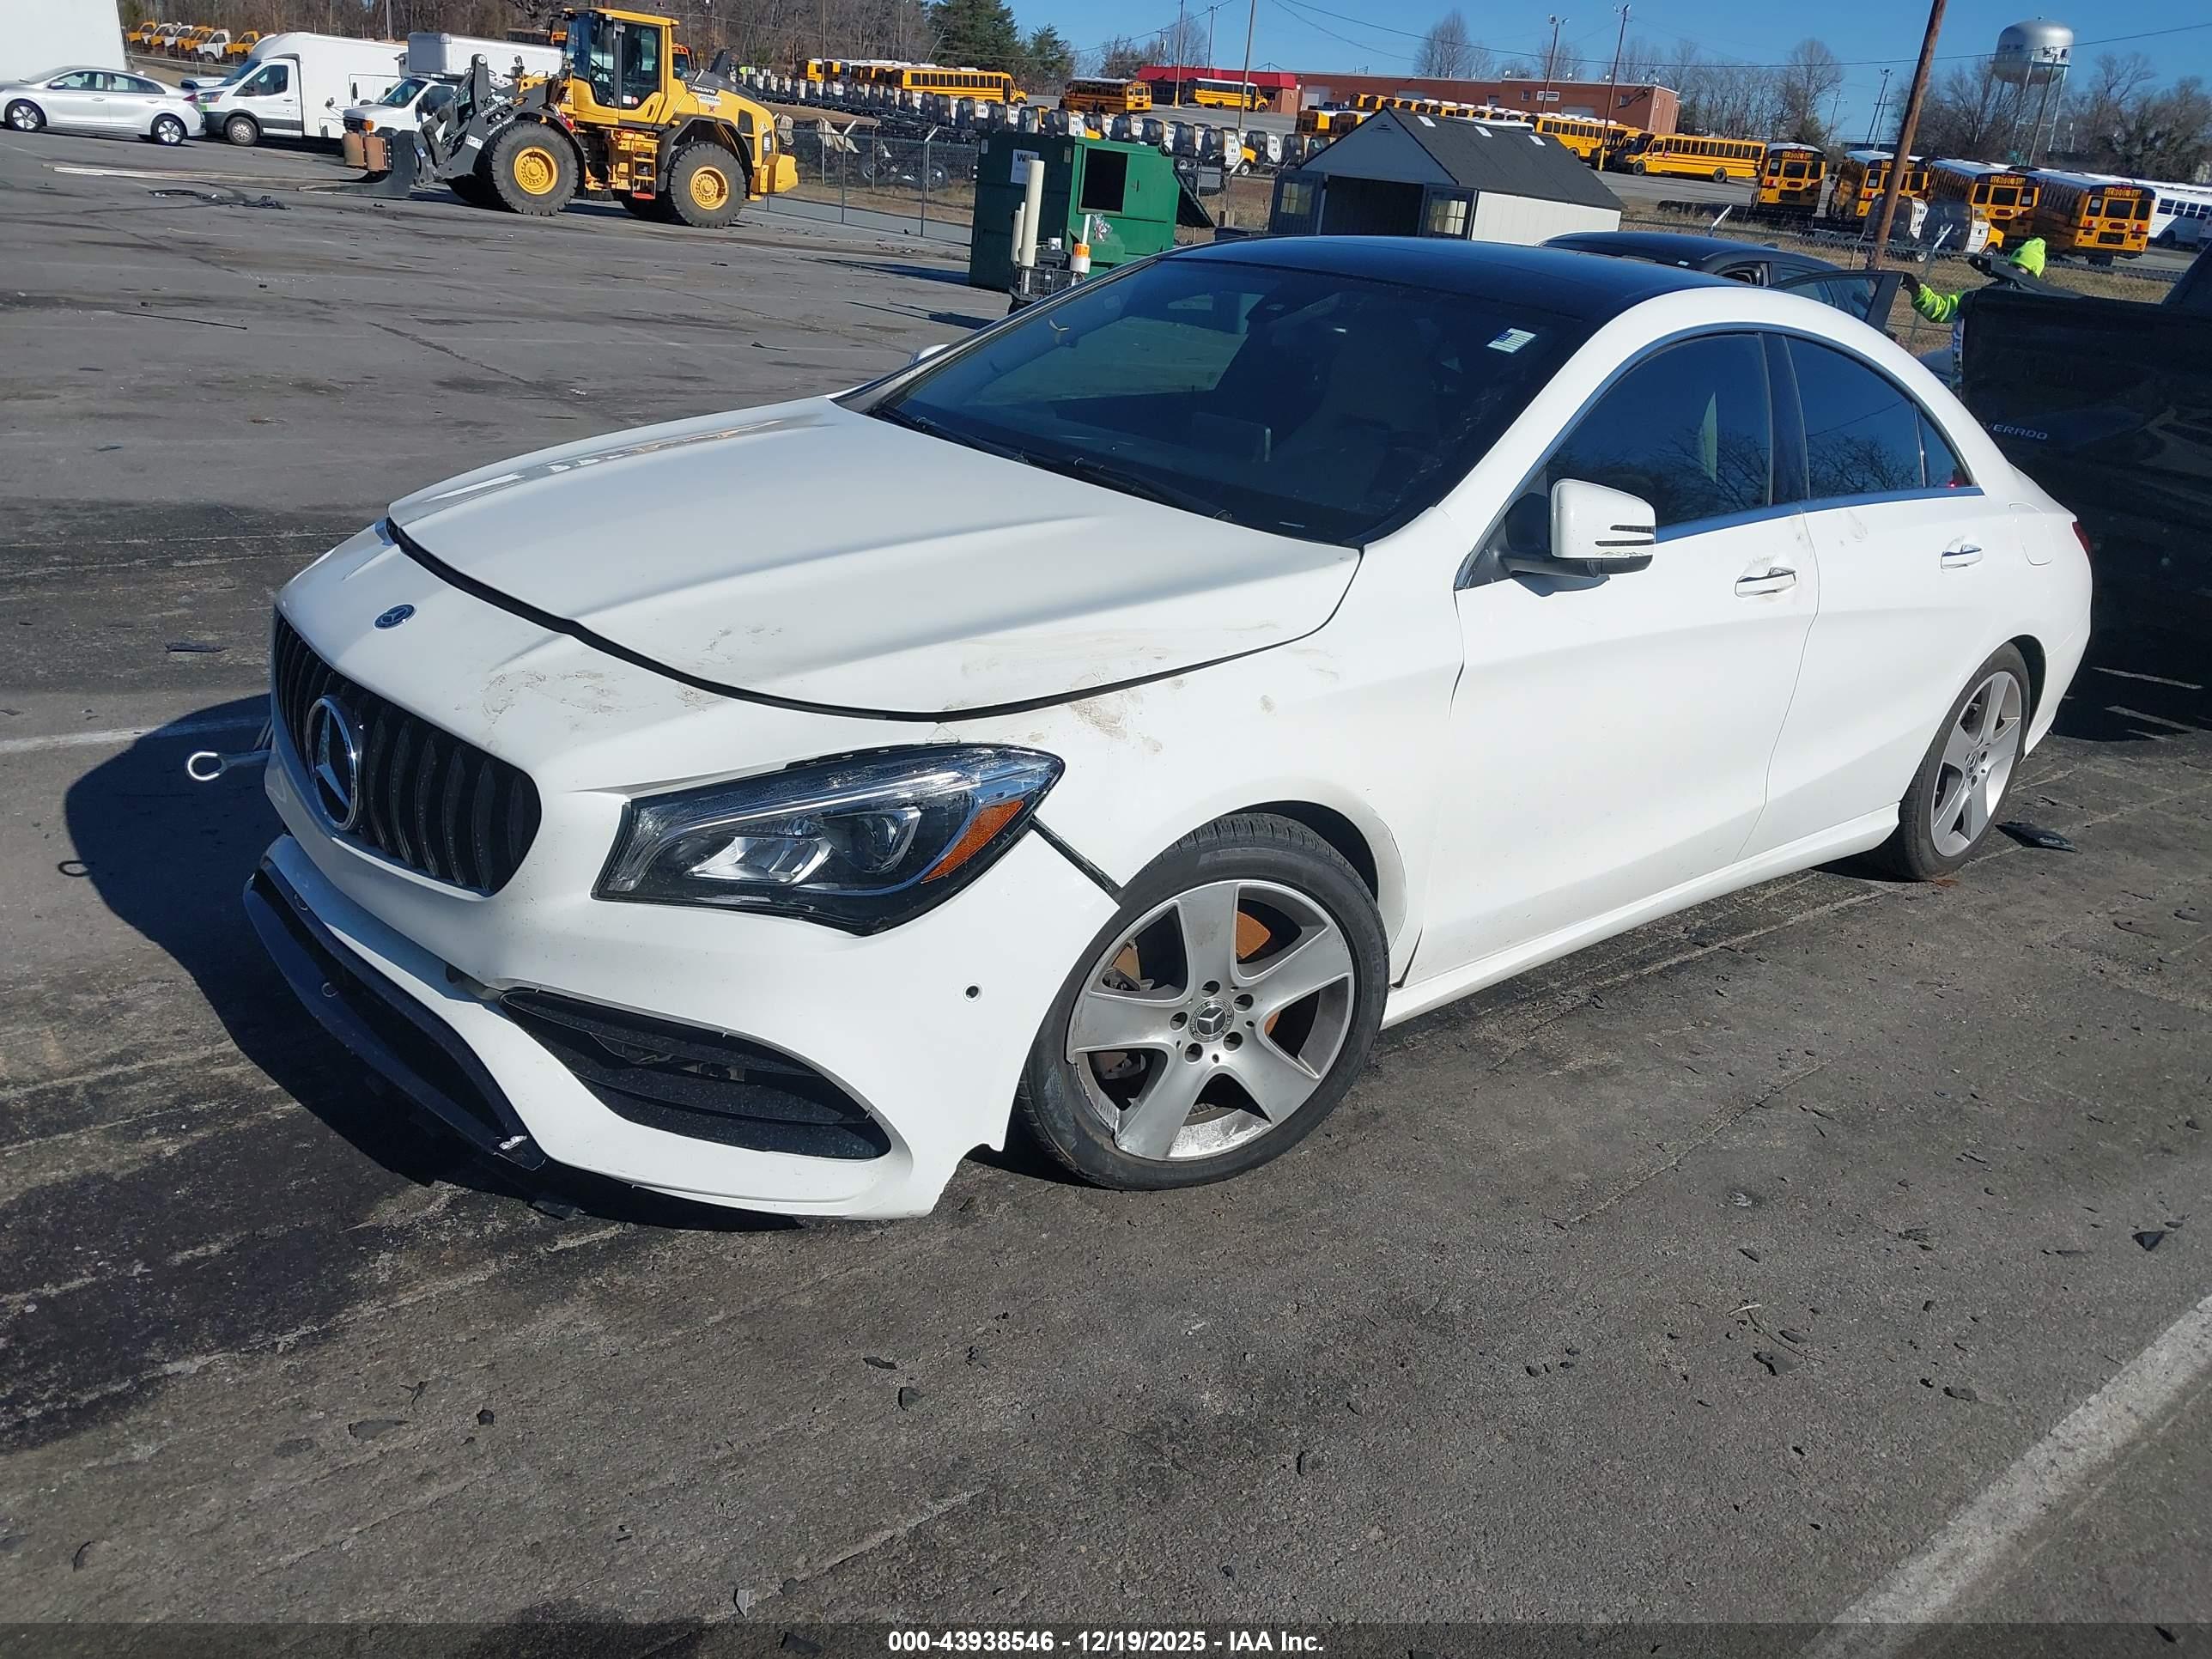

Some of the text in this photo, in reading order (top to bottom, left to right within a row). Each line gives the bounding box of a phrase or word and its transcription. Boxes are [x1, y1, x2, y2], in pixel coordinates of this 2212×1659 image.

[688, 84, 716, 94] VOLVO
[489, 103, 499, 113] NOT
[499, 96, 514, 107] WALK
[502, 115, 515, 126] MAST
[1990, 175, 2015, 185] SCHOOL
[2105, 186, 2130, 198] SCHOOL
